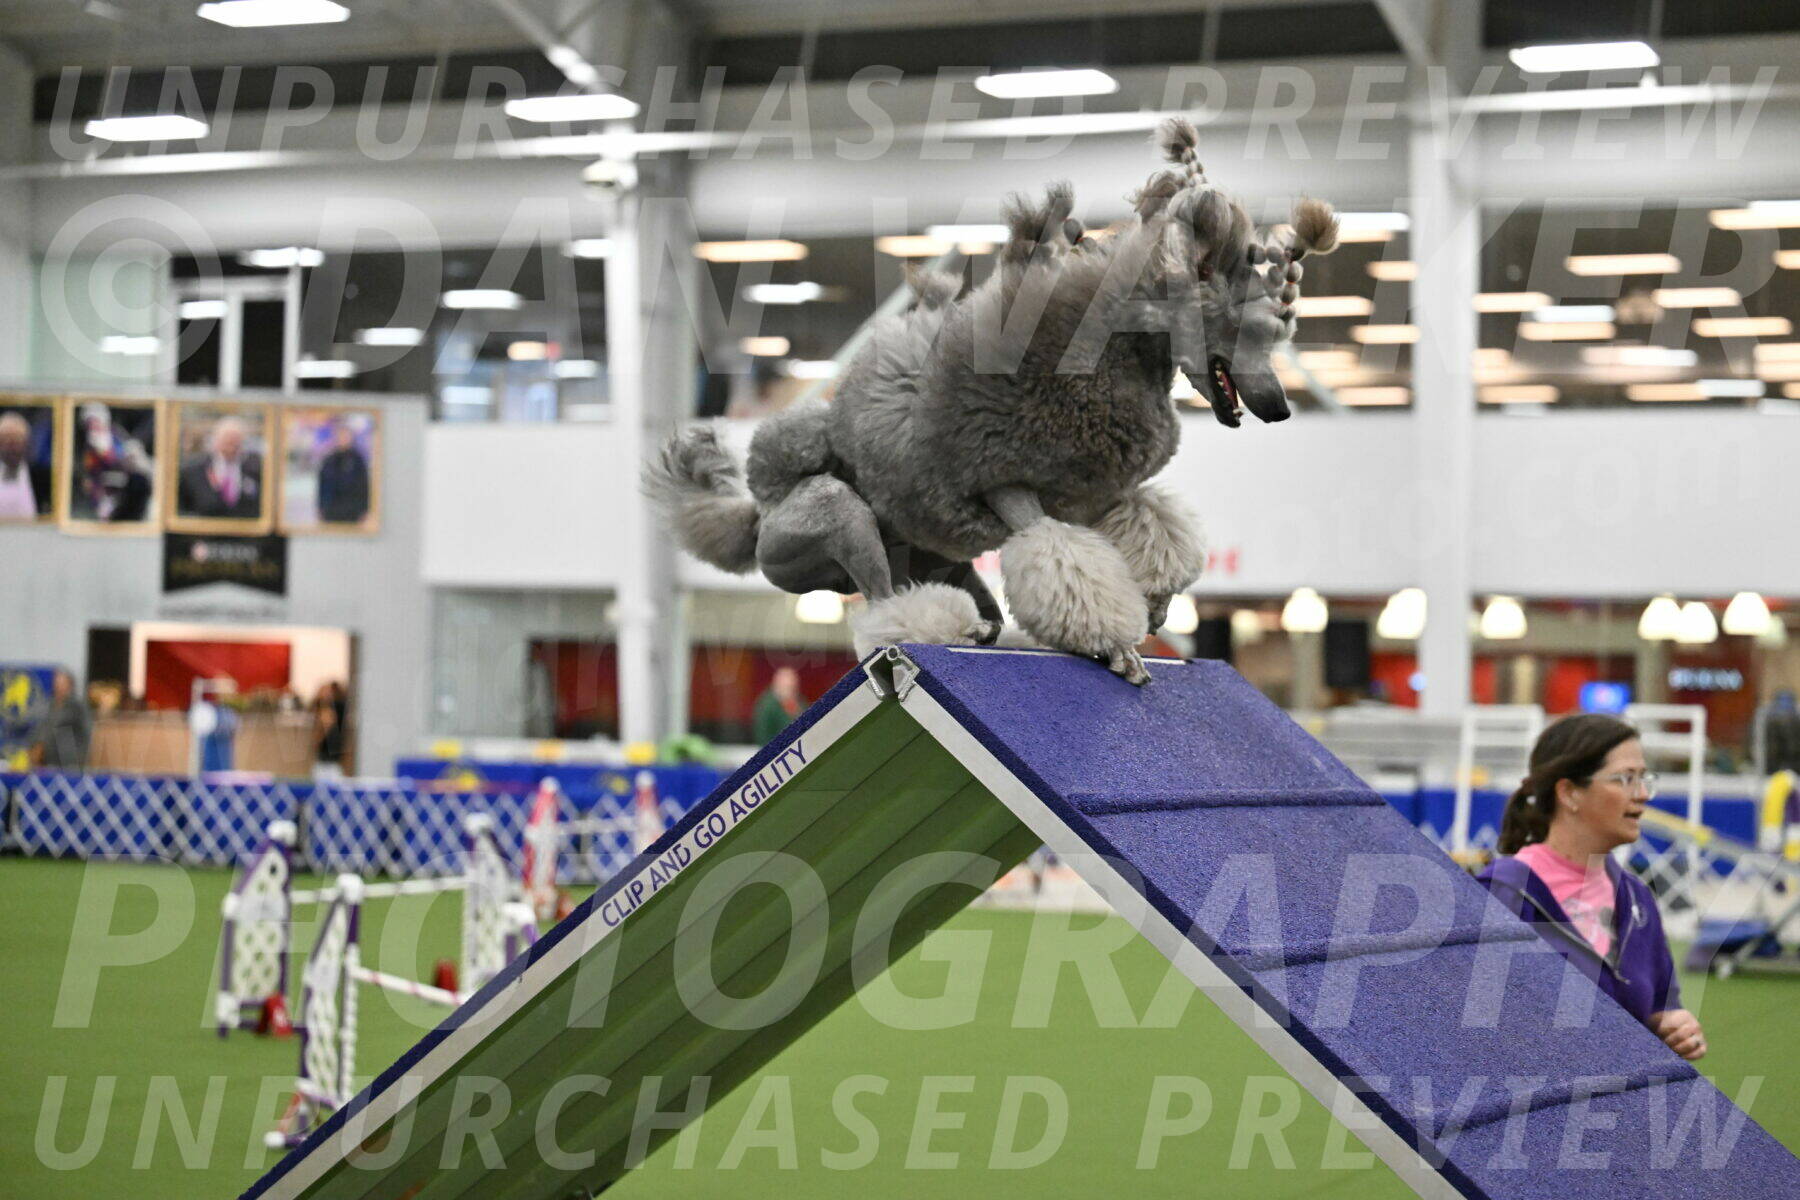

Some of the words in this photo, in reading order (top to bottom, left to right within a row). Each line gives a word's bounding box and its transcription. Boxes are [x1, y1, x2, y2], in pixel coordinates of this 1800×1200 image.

[602, 880, 644, 928] CLIP
[650, 842, 691, 892] AND
[693, 812, 727, 850] GO
[730, 739, 807, 823] AGILITY
